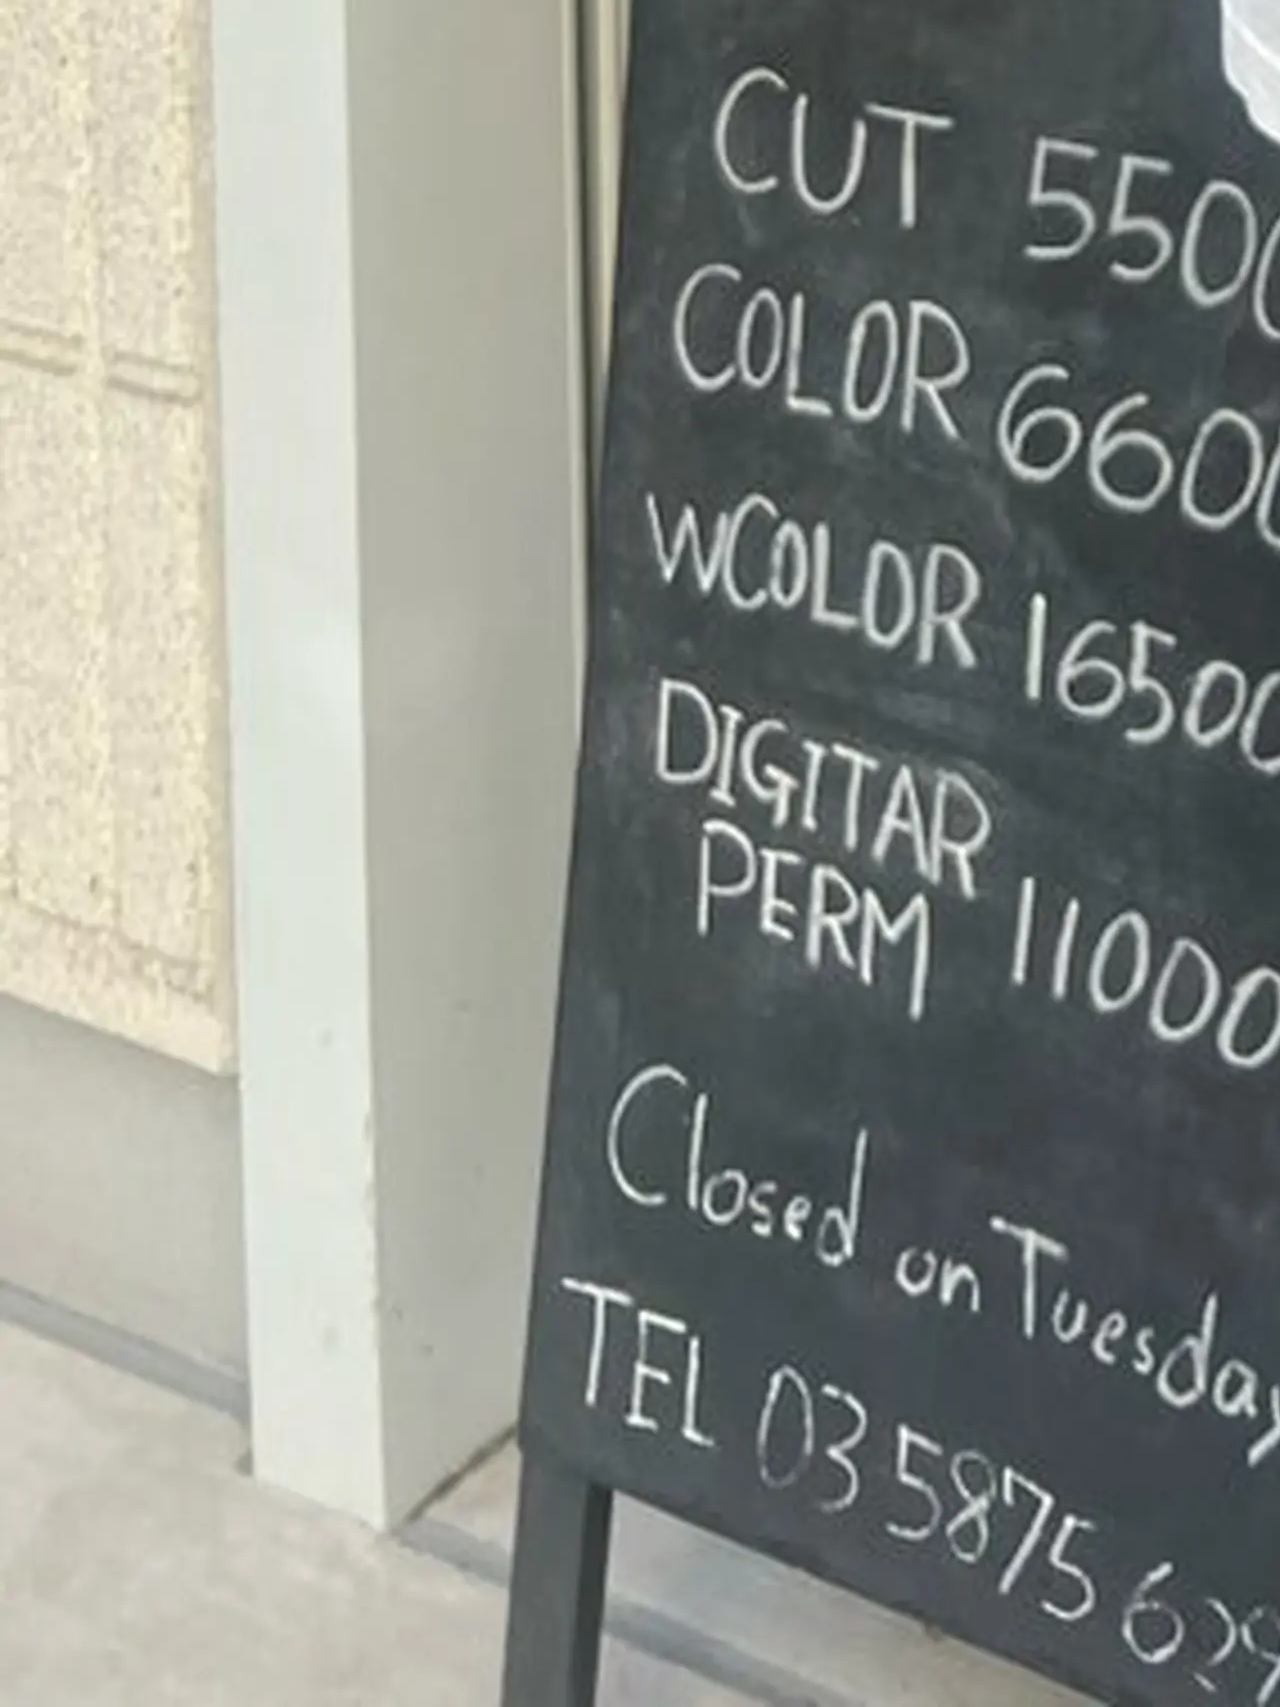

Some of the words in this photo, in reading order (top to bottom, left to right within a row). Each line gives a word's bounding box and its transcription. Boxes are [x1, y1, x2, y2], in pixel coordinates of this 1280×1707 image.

[712, 66, 954, 229] CUT
[672, 262, 971, 439] COLOR
[654, 676, 993, 901] DIGITAR
[697, 817, 931, 1021] PERM
[607, 1063, 869, 1269] Closed
[893, 1248, 981, 1314] on
[560, 1276, 715, 1448] TEL
